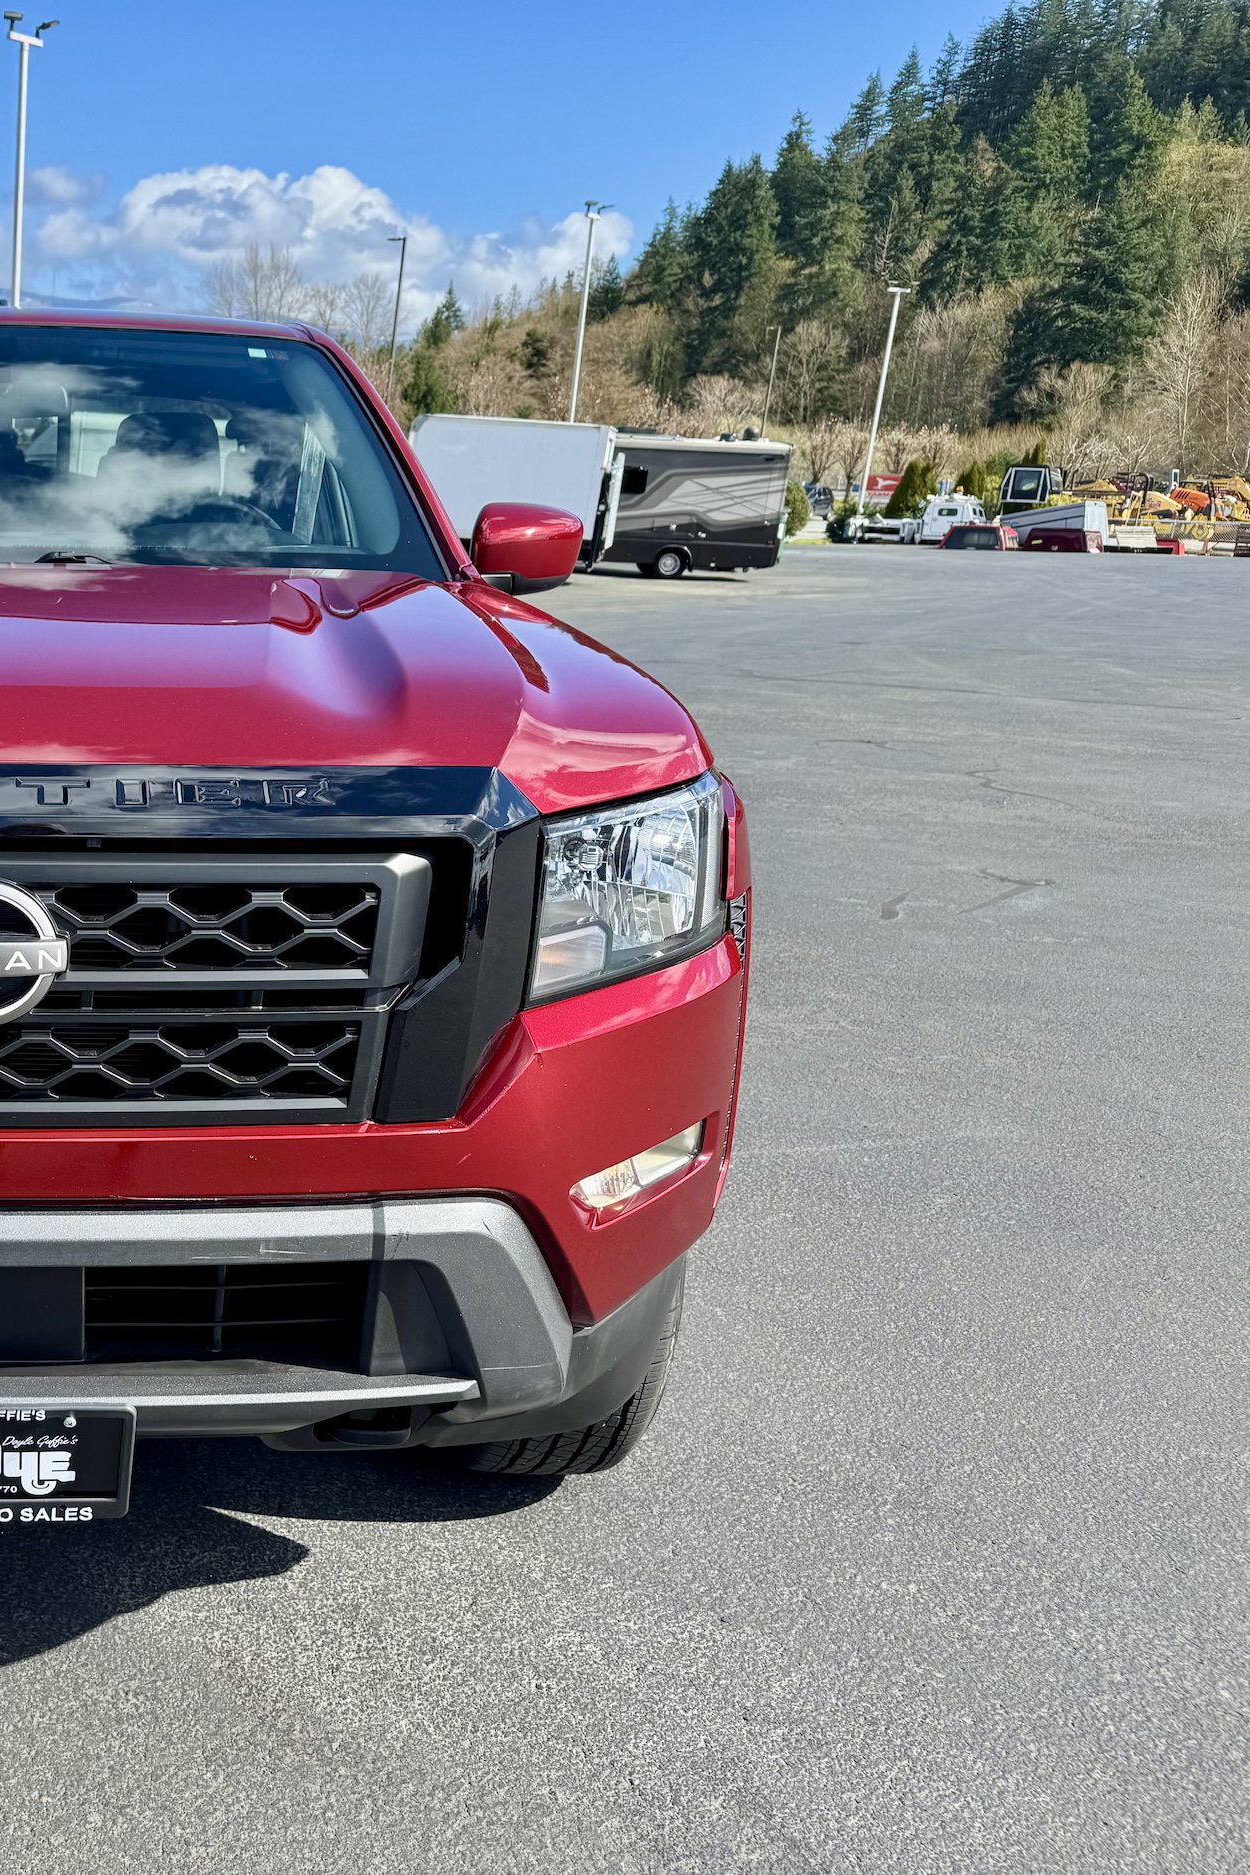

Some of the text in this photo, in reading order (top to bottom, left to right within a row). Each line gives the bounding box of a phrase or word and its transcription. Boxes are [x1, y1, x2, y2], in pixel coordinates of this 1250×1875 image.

[2, 1434, 79, 1449] Doyle Guffie's
[19, 1506, 93, 1522] SALES
